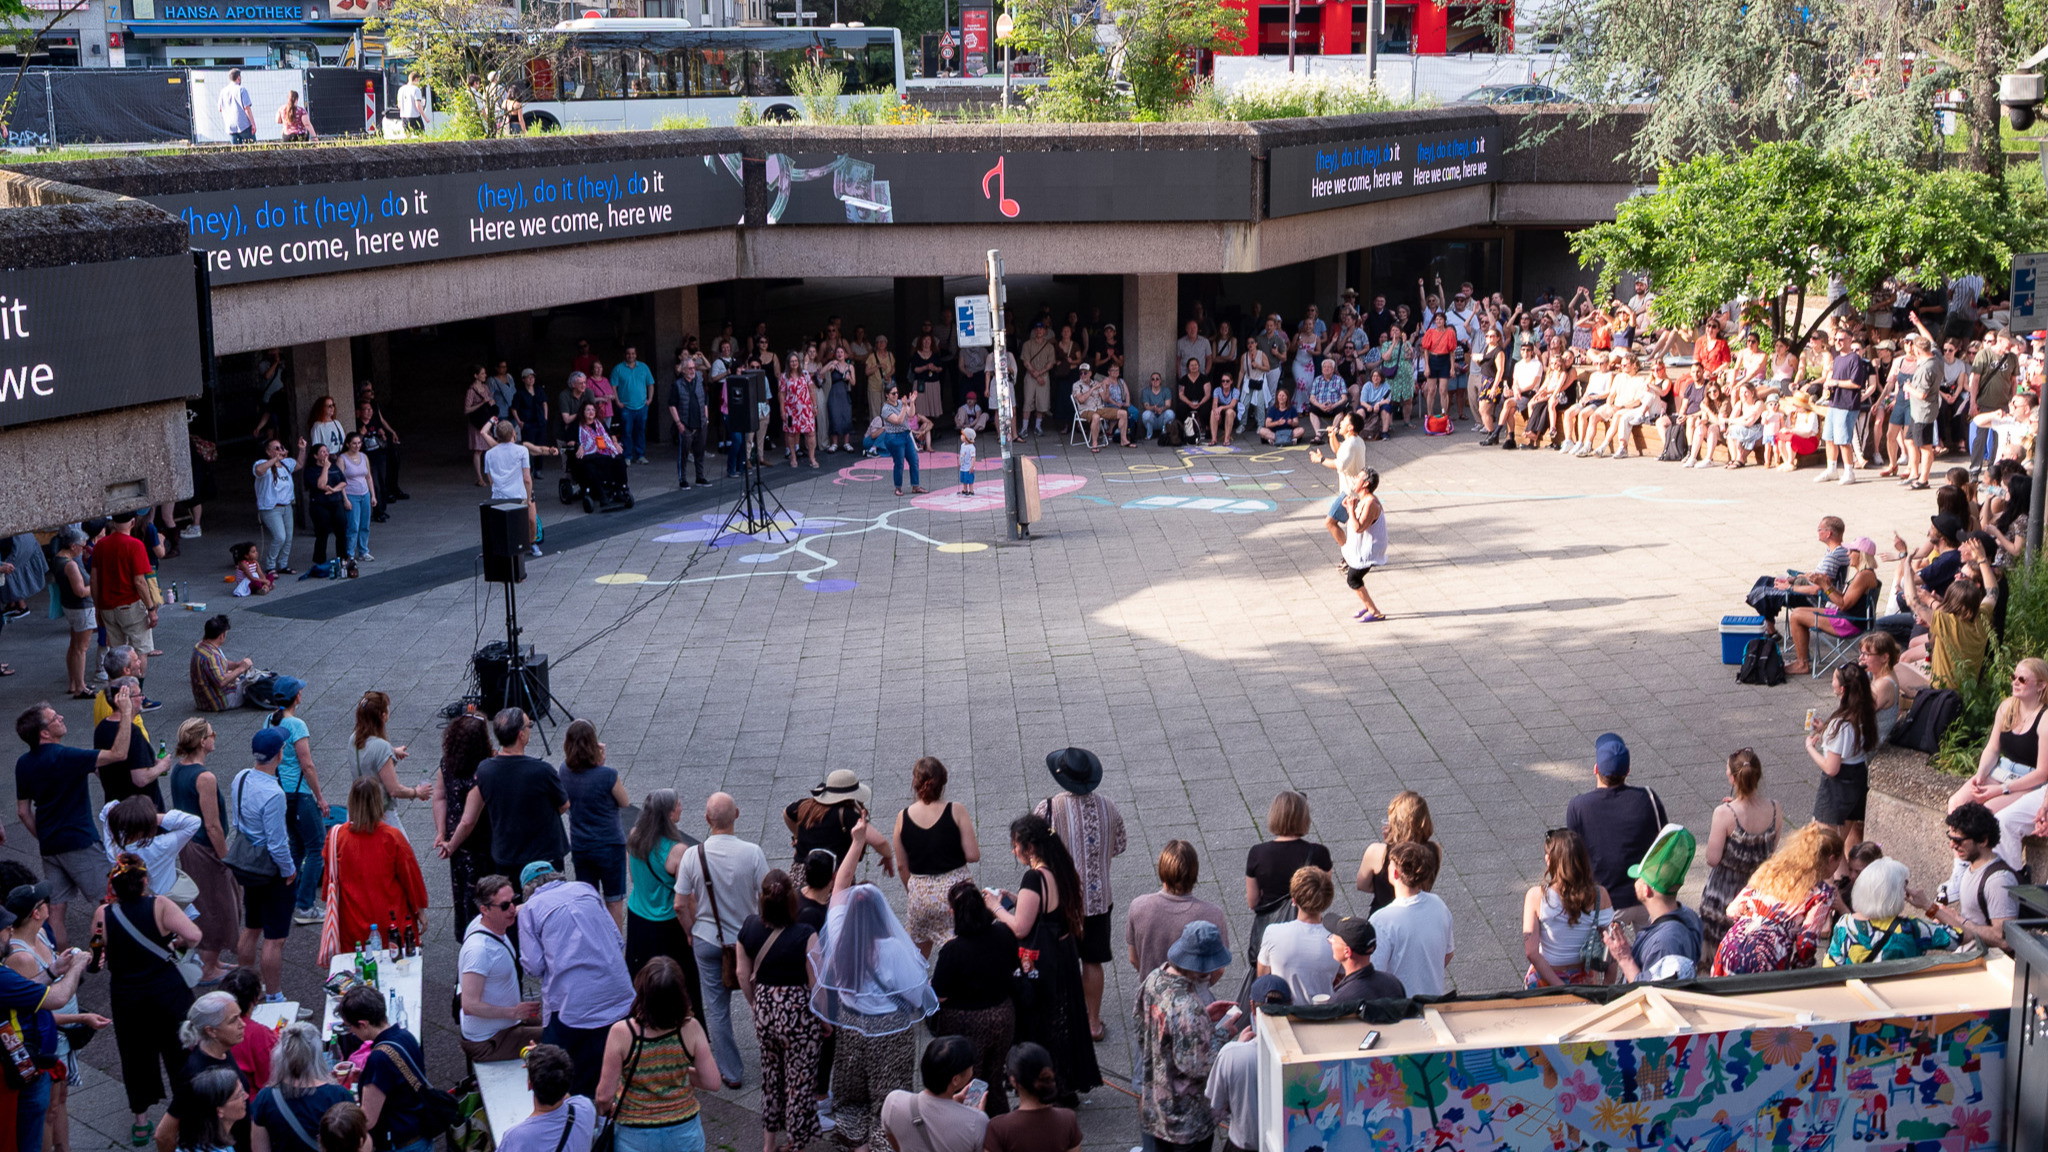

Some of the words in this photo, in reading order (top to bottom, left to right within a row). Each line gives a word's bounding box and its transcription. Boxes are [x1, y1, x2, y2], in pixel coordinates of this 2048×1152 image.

[109, 5, 118, 18] 7
[165, 6, 219, 19] HANSA
[225, 6, 302, 19] APOTHEKE
[1316, 149, 1339, 175] (hey),
[1341, 146, 1353, 168] do
[1354, 146, 1360, 166] it
[1361, 144, 1382, 169] (hey),
[1383, 143, 1393, 162] do
[1394, 142, 1400, 162] it
[1437, 140, 1446, 159] do
[1447, 139, 1453, 157] it
[1471, 137, 1480, 154] do
[1480, 135, 1485, 153] it
[1312, 177, 1333, 199] Here
[1334, 177, 1347, 195] we
[1347, 174, 1372, 193] come,
[1373, 168, 1391, 189] here
[1391, 170, 1403, 186] we
[1413, 167, 1430, 186] Here
[1431, 168, 1441, 183] we
[1442, 165, 1462, 182] come,
[1462, 160, 1477, 179] here
[1477, 161, 1487, 176] we
[255, 200, 285, 229] do
[293, 200, 308, 225] it
[315, 195, 374, 228] (hey),
[380, 190, 408, 217] do
[414, 189, 428, 215] it
[477, 181, 528, 213] (hey),
[533, 178, 557, 203] do
[562, 178, 574, 200] it
[577, 174, 623, 204] (hey),
[627, 171, 649, 195] do
[653, 170, 665, 193] it
[469, 217, 516, 243] Here
[519, 217, 547, 238] we
[551, 211, 604, 234] come,
[608, 203, 646, 228] here
[649, 204, 673, 223] we
[207, 249, 231, 272] re
[238, 245, 273, 268] we
[280, 238, 349, 264] come,
[355, 228, 404, 255] here
[409, 227, 439, 249] we
[0, 295, 30, 340] it
[0, 363, 54, 402] we
